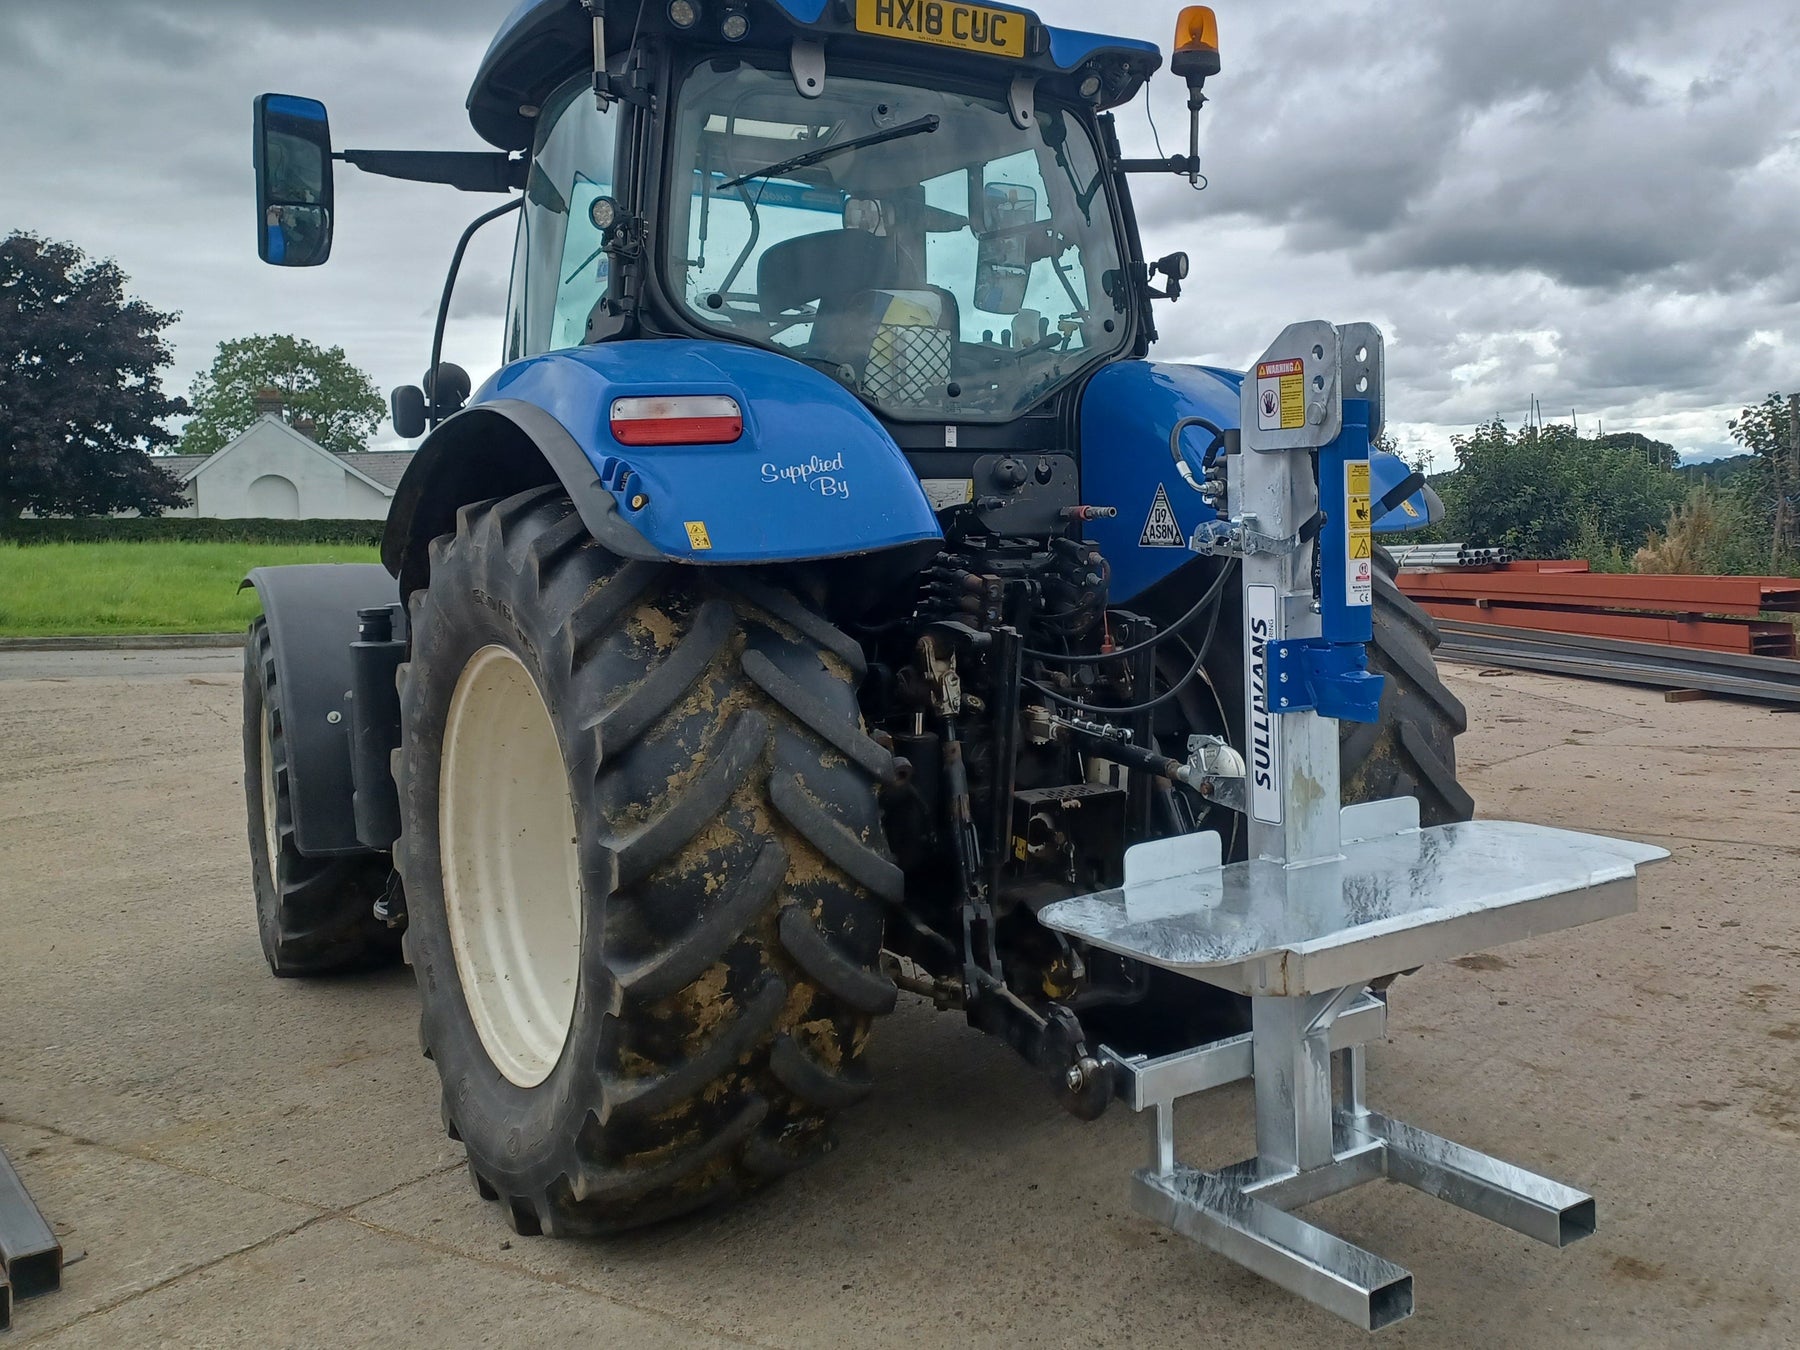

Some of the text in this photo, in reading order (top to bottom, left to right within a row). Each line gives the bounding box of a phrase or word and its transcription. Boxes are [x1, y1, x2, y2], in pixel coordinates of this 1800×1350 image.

[875, 0, 1007, 46] HX18 CUC
[1265, 362, 1294, 375] WARNING
[761, 452, 845, 484] Supplied
[809, 476, 849, 499] By
[1251, 617, 1271, 790] SULLIVANS
